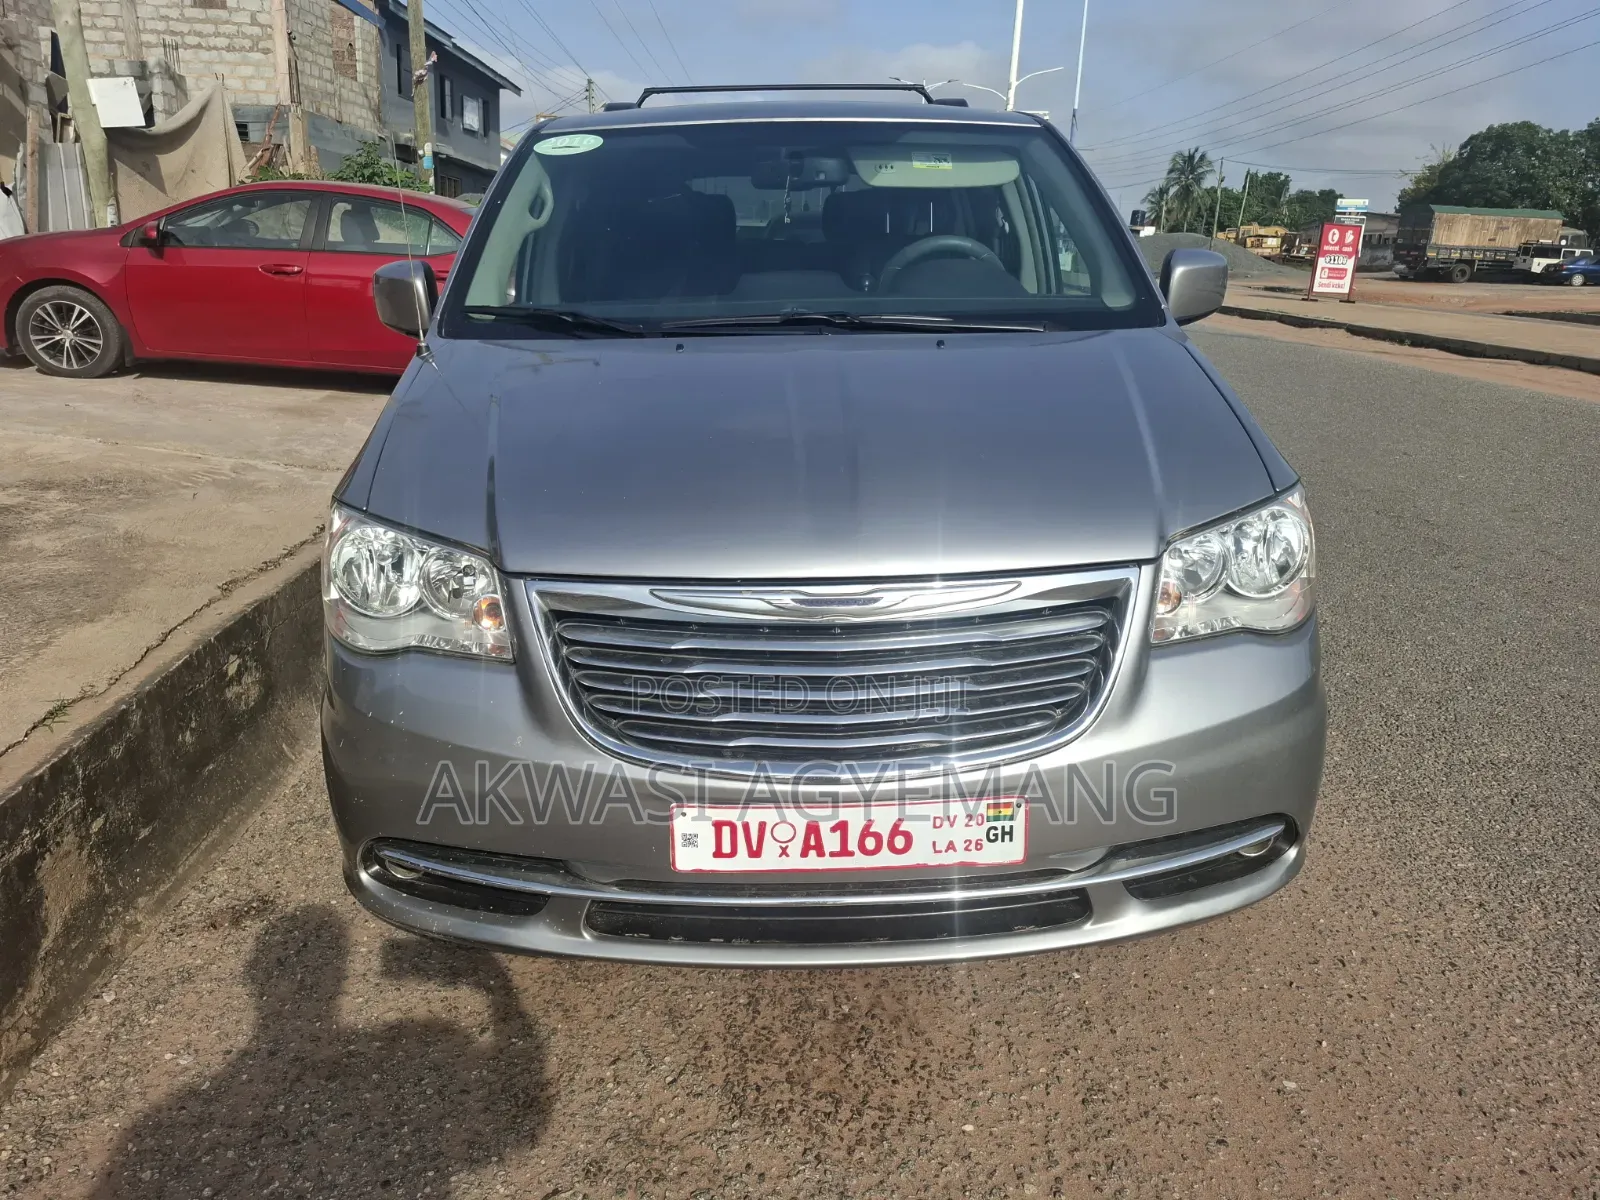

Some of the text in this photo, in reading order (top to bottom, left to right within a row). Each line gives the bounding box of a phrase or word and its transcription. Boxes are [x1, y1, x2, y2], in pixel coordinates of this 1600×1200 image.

[932, 813, 985, 829] DV 20
[711, 819, 767, 859] DV
[799, 819, 914, 859] A166
[985, 825, 1014, 843] GH
[932, 838, 984, 854] LA 26
